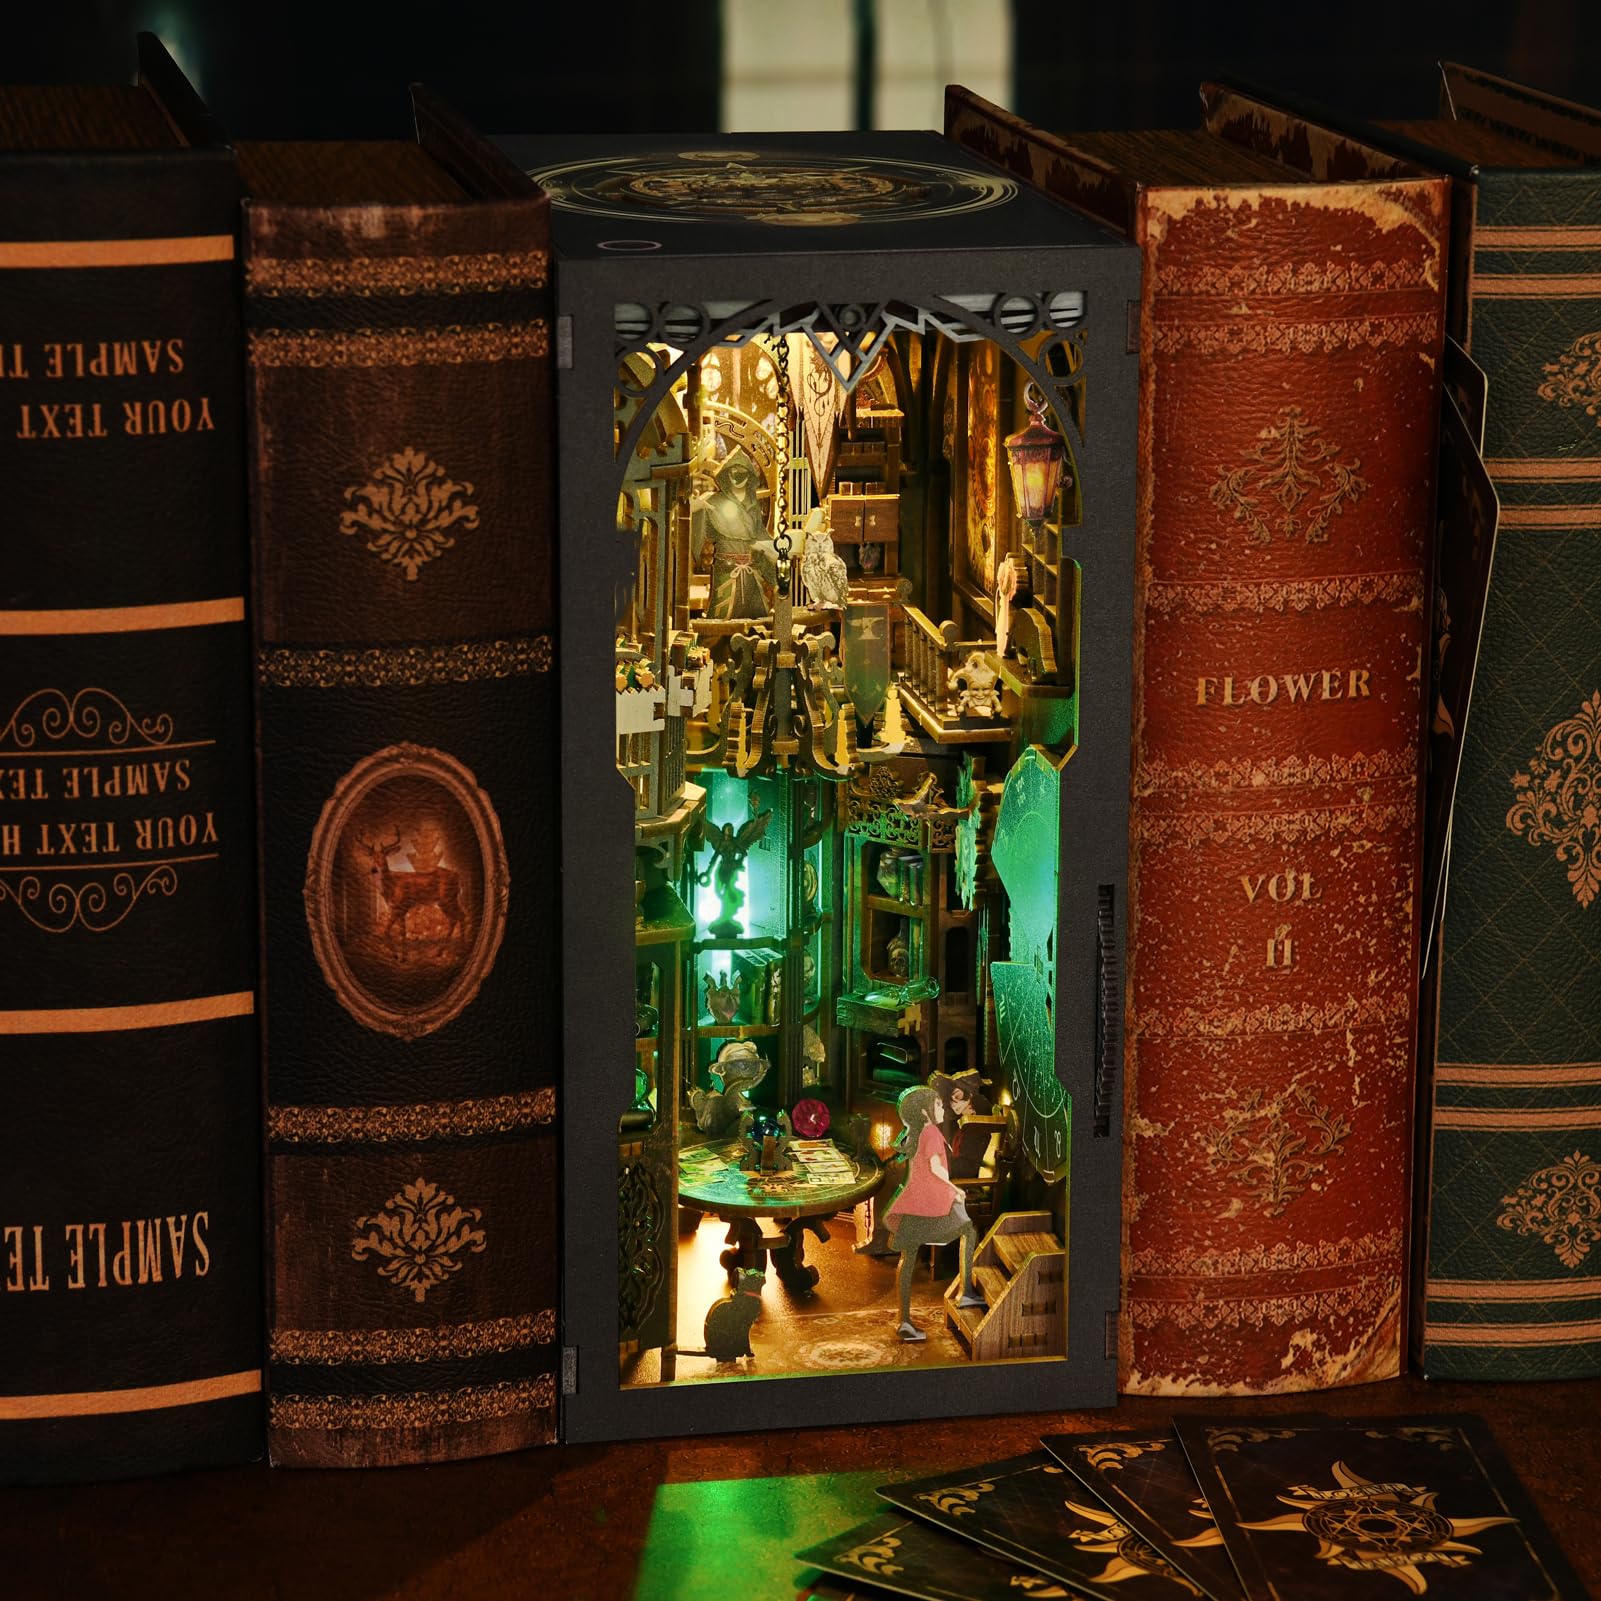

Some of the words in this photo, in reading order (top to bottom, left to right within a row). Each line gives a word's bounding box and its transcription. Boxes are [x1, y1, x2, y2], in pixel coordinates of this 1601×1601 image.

[0, 344, 29, 378] T
[44, 339, 184, 378] SAMPLE
[16, 403, 107, 438] TEXT
[123, 397, 215, 435] YOUR
[1196, 669, 1370, 706] FLOWER
[63, 759, 191, 799] SAMPLE
[36, 821, 120, 855] TEXT
[135, 812, 219, 850] YOUR
[1240, 868, 1322, 903] VOL
[65, 1211, 210, 1290] SAMPLE
